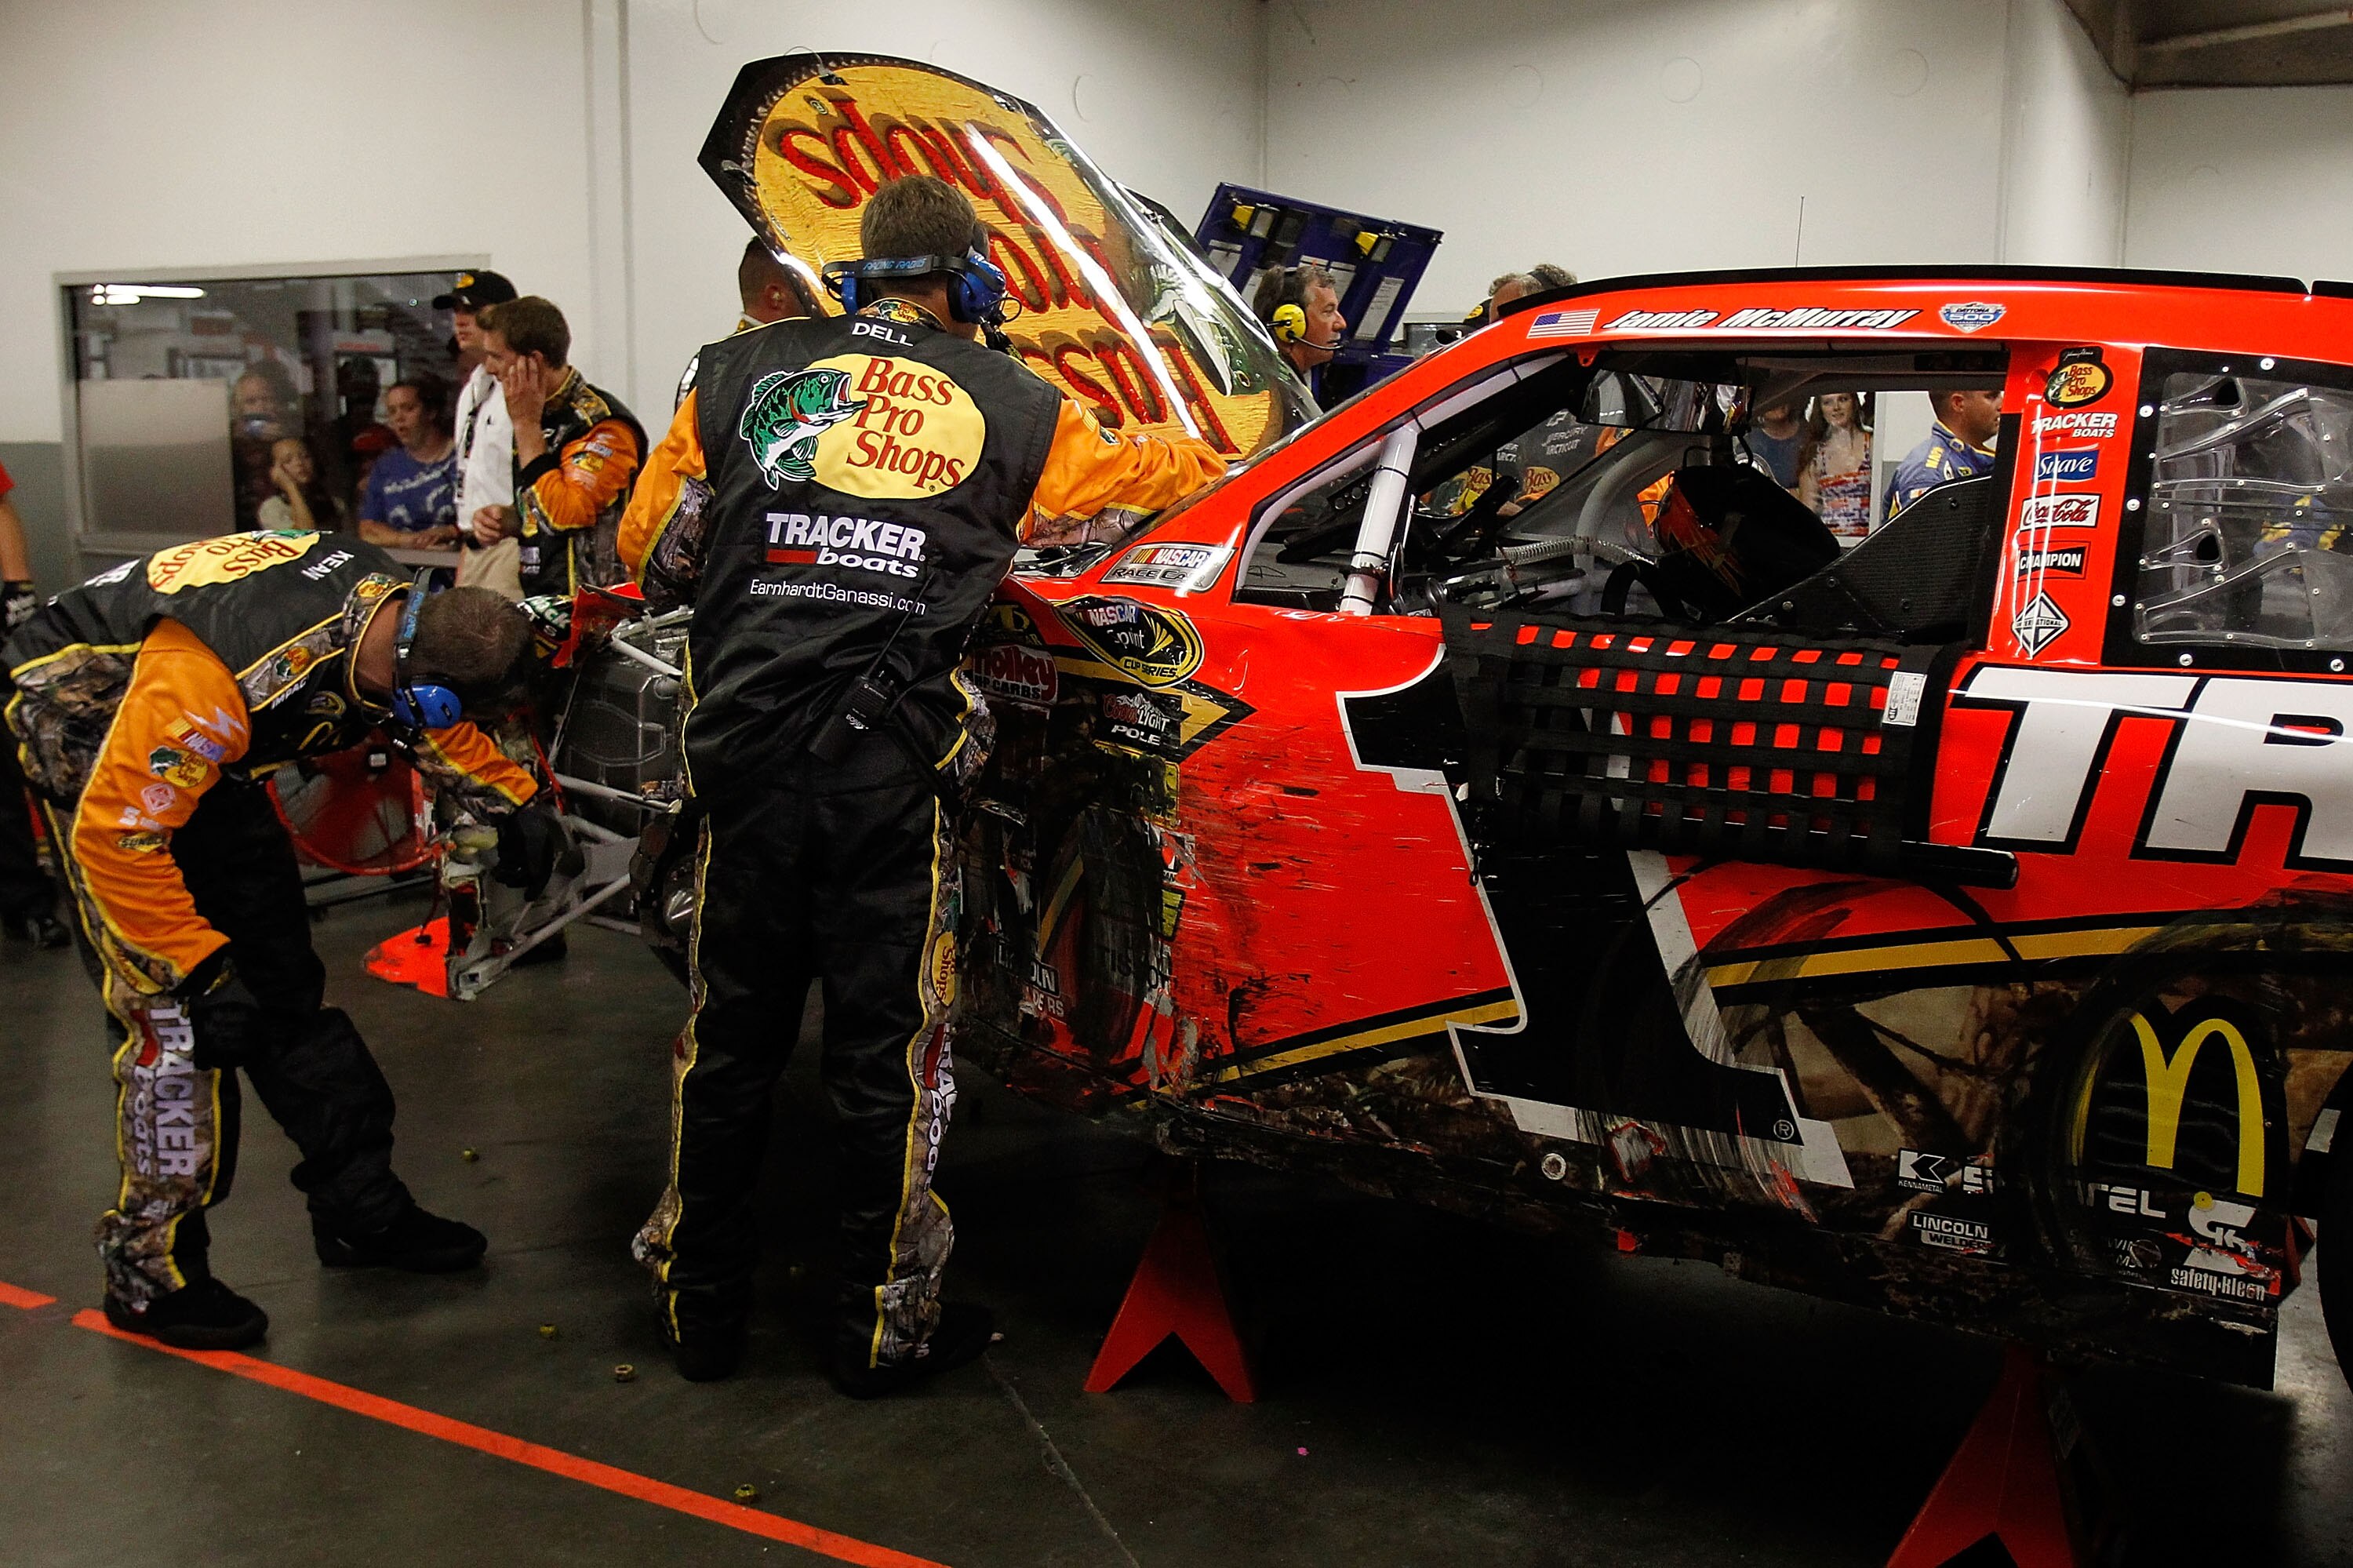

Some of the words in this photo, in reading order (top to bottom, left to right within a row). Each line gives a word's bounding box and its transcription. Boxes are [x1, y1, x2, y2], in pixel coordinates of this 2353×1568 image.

[1602, 309, 1719, 329] Jamie
[1715, 308, 1924, 329] McMurray
[852, 322, 914, 347] DELL
[856, 357, 955, 406] Bass
[2067, 377, 2086, 387] Pro
[2068, 365, 2093, 377] Bass
[2066, 385, 2097, 398] Shops
[851, 392, 925, 436] Pro
[2031, 413, 2118, 435] TRACKER
[2071, 427, 2115, 438] BOATS
[847, 429, 966, 490] Shops
[2038, 456, 2093, 478] Suave
[766, 513, 924, 562] TRACKER
[223, 540, 302, 577] Bass
[300, 550, 355, 581] KEAN
[816, 548, 919, 579] boats
[1152, 549, 1212, 569] NASCAR
[1111, 567, 1158, 580] RACE
[1089, 605, 1139, 627] NASCAR
[1107, 627, 1146, 650] Sprint
[1140, 664, 1179, 678] SERIES
[991, 679, 1041, 700] CARBS
[1102, 693, 1139, 725] Coors
[1137, 707, 1171, 733] LIGHT
[1110, 724, 1162, 747] POLE
[933, 945, 949, 1001] Shops
[149, 996, 196, 1178] TRACKER
[1898, 1179, 1945, 1194] KENNAMETAL
[1912, 1214, 1989, 1239] LINCOLN
